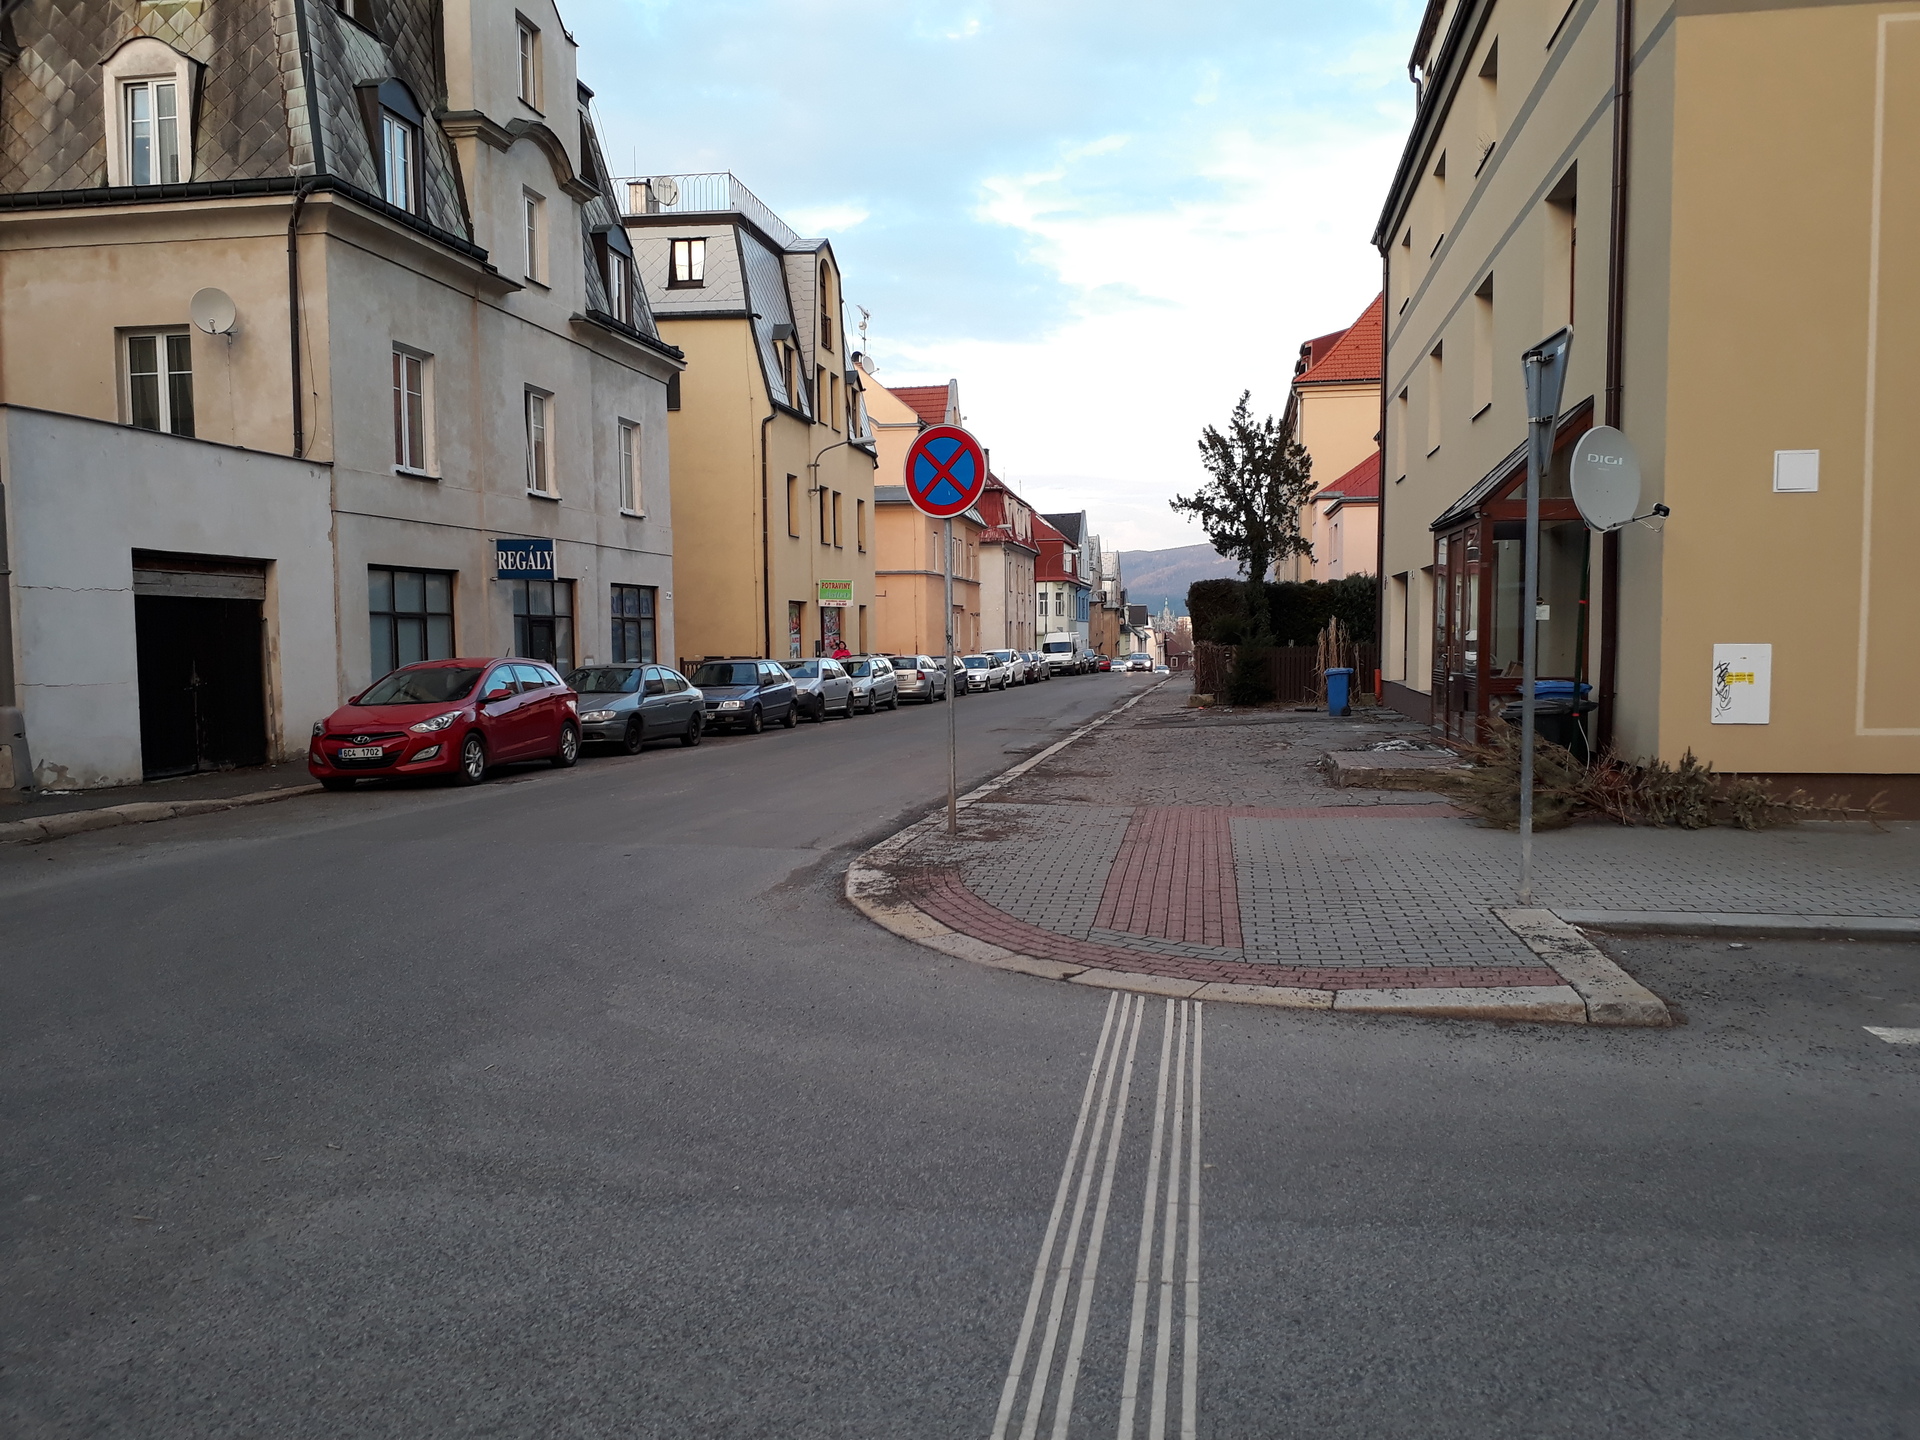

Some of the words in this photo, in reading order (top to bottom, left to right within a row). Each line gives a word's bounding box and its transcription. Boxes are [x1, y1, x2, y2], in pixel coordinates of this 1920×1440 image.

[1587, 453, 1622, 465] DIGI
[497, 544, 553, 570] REGÁLY
[362, 748, 380, 756] 1702
